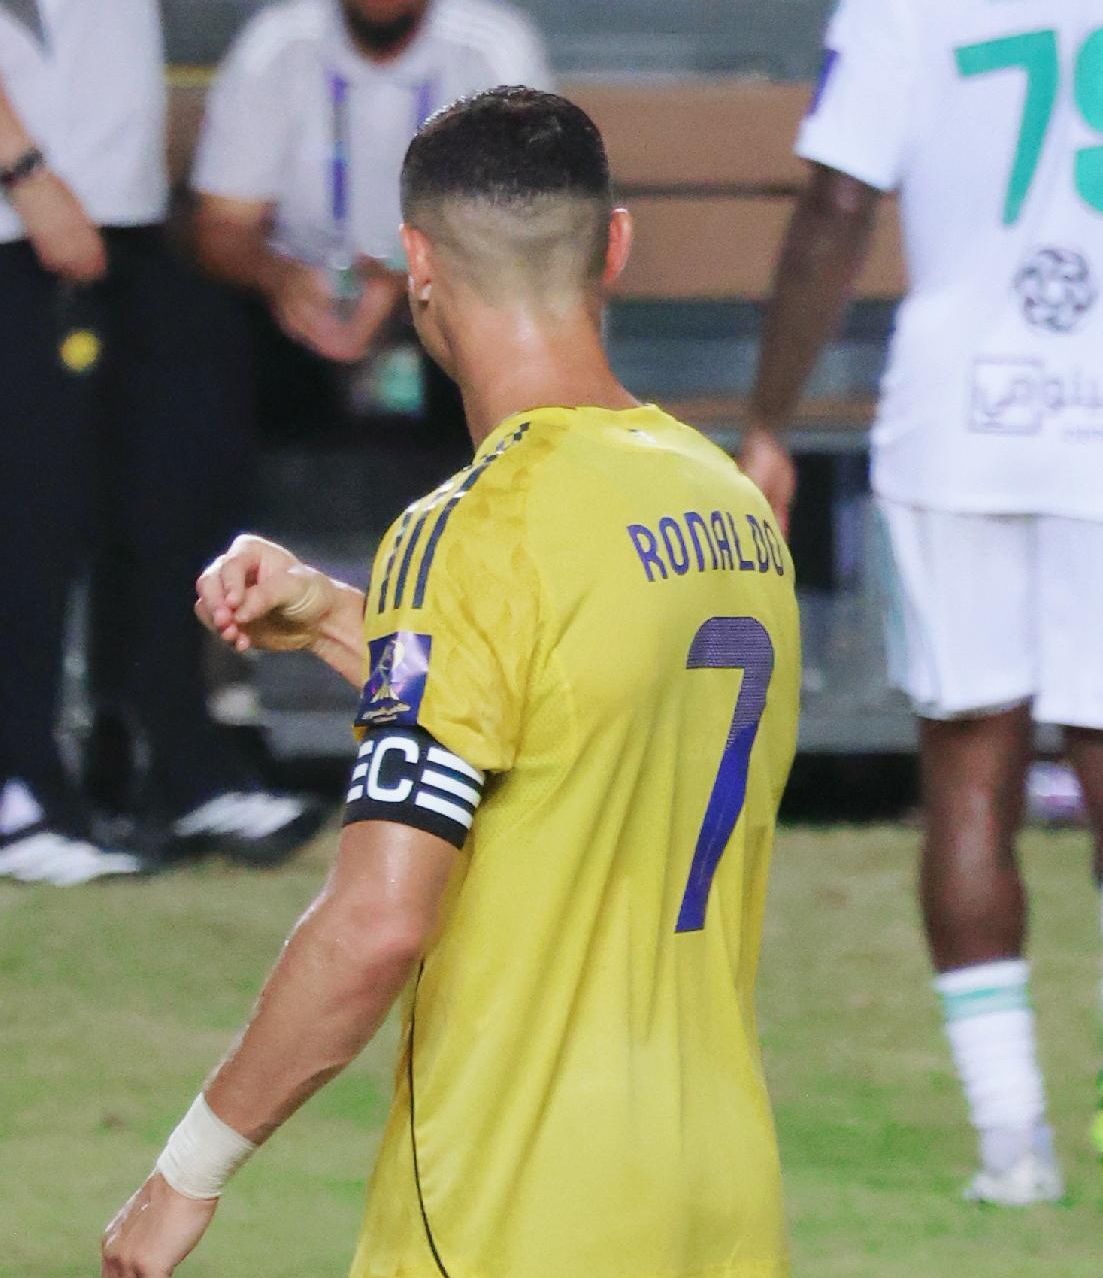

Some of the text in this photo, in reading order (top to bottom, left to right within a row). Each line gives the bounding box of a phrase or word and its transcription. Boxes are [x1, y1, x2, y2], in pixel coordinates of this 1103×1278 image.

[627, 509, 785, 583] RONALDO
[367, 736, 420, 803] C
[674, 616, 775, 934] 7
